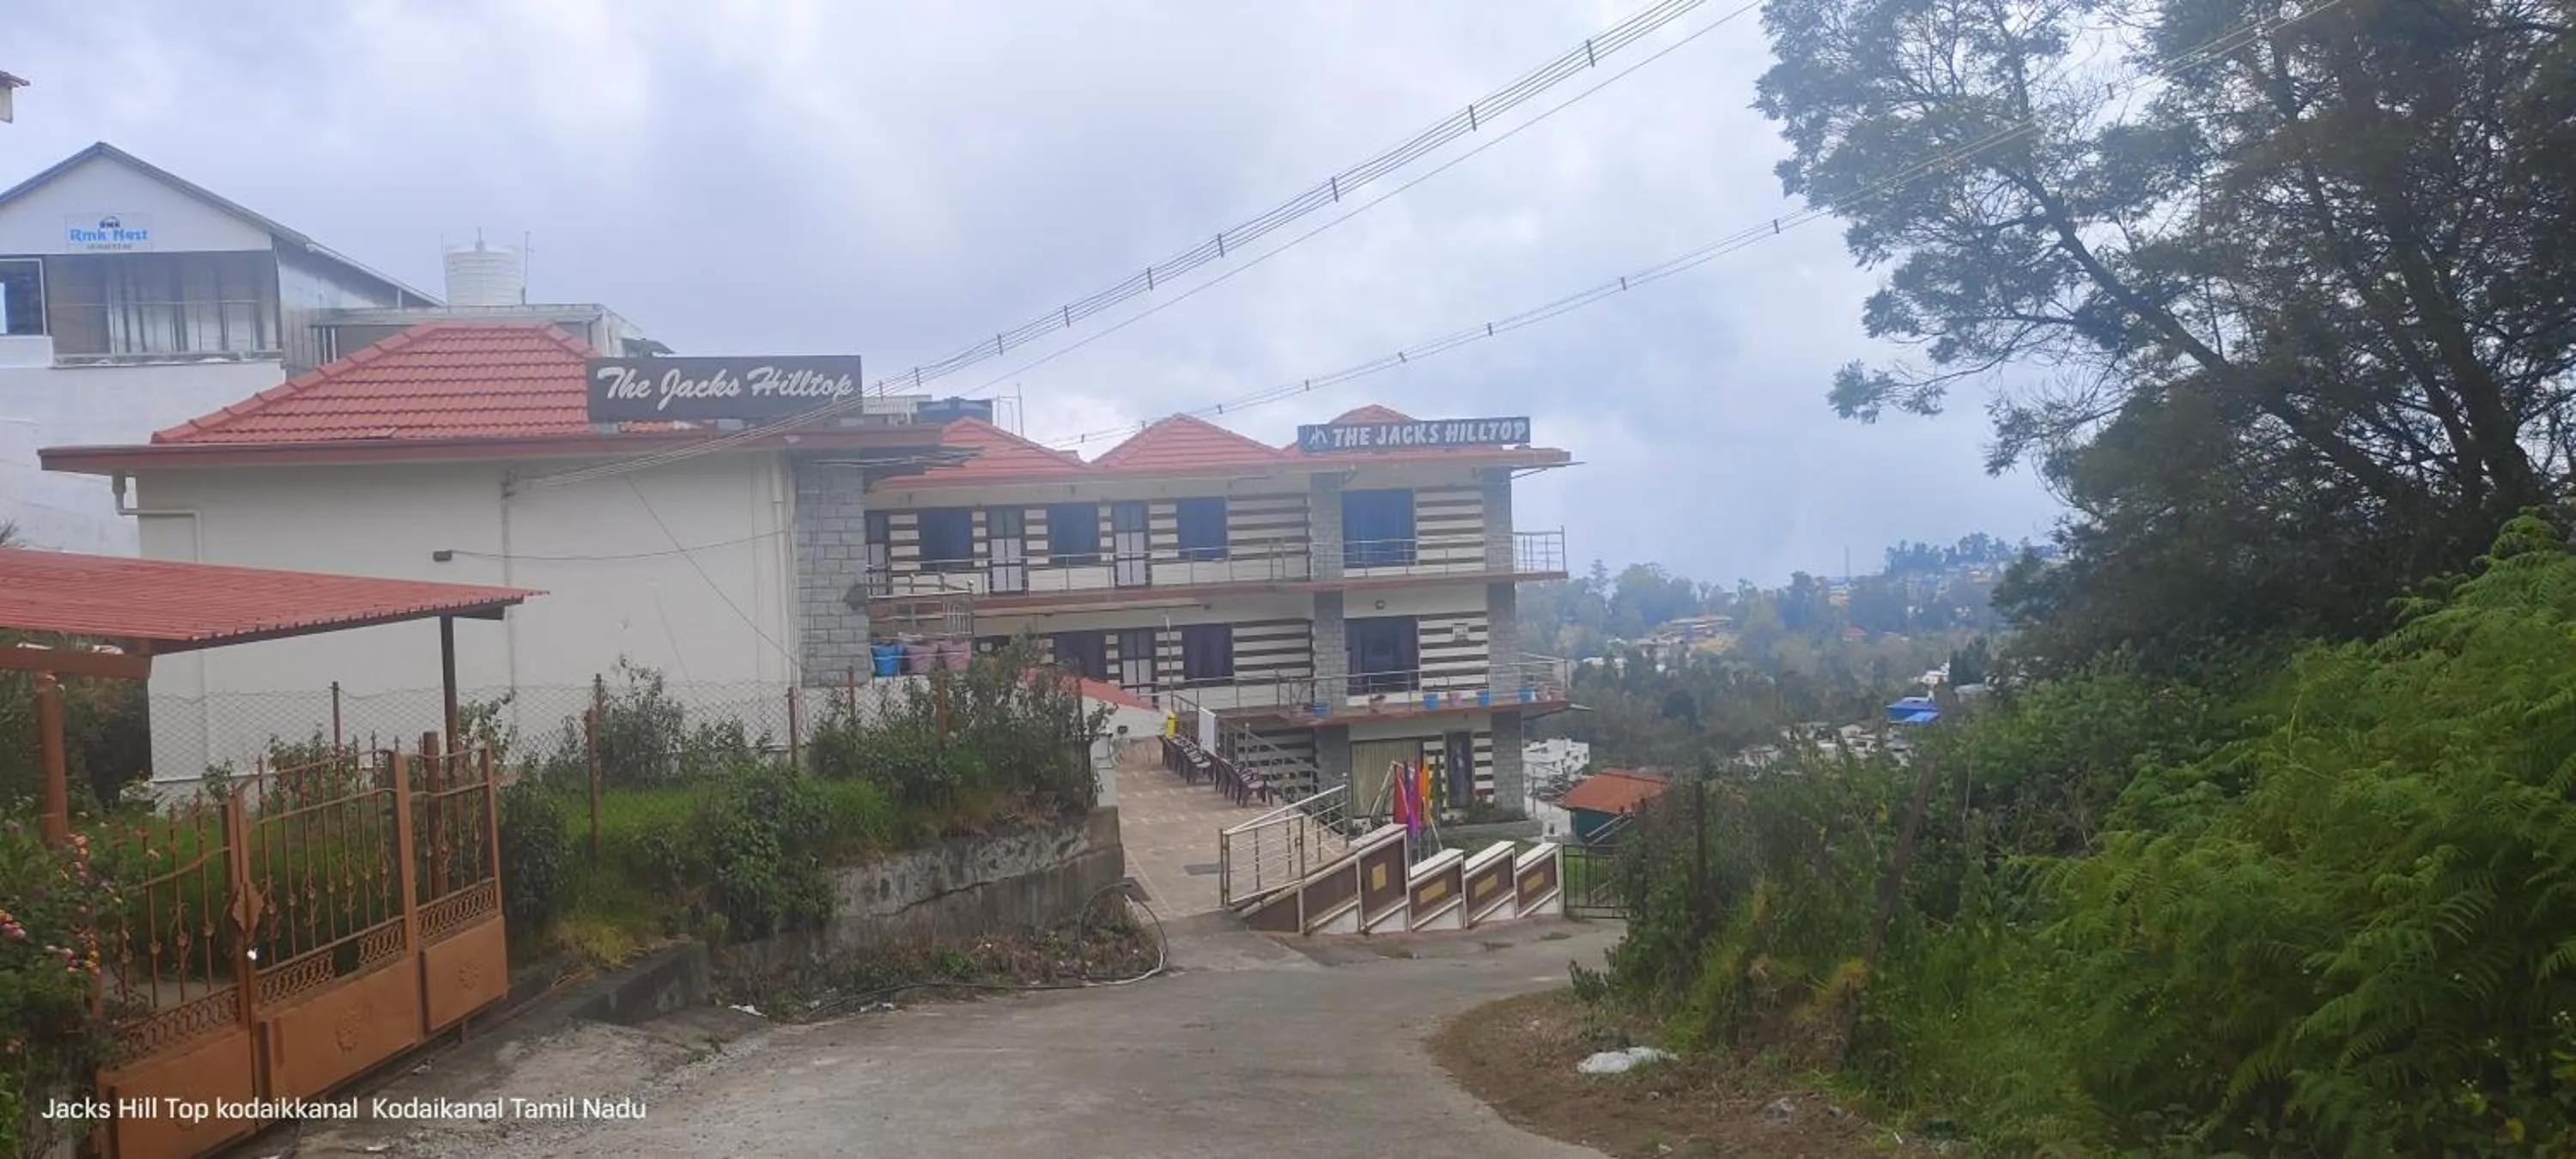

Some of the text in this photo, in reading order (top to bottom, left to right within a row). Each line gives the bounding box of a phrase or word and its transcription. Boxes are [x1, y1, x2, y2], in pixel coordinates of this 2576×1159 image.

[70, 229, 148, 241] Rmk Nest
[597, 366, 854, 411] The Jacks Hilltop
[1333, 420, 1527, 447] THE JACKS HILLTOP
